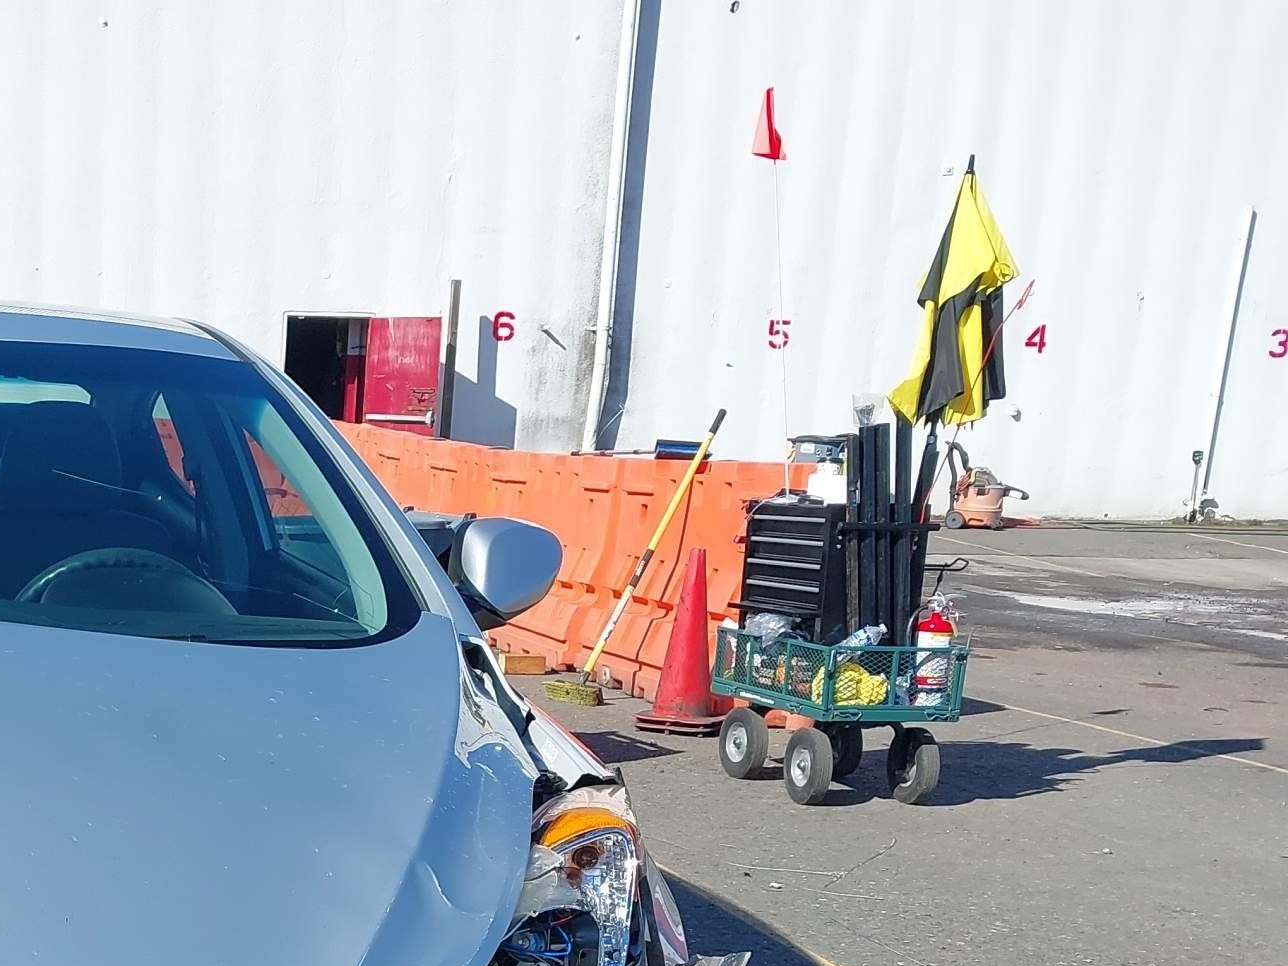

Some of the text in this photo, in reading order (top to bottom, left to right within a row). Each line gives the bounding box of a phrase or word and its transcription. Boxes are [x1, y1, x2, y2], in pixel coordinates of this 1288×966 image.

[492, 311, 515, 342] 6
[768, 319, 791, 350] 5
[1024, 325, 1047, 353] 4
[1268, 329, 1288, 358] 3
